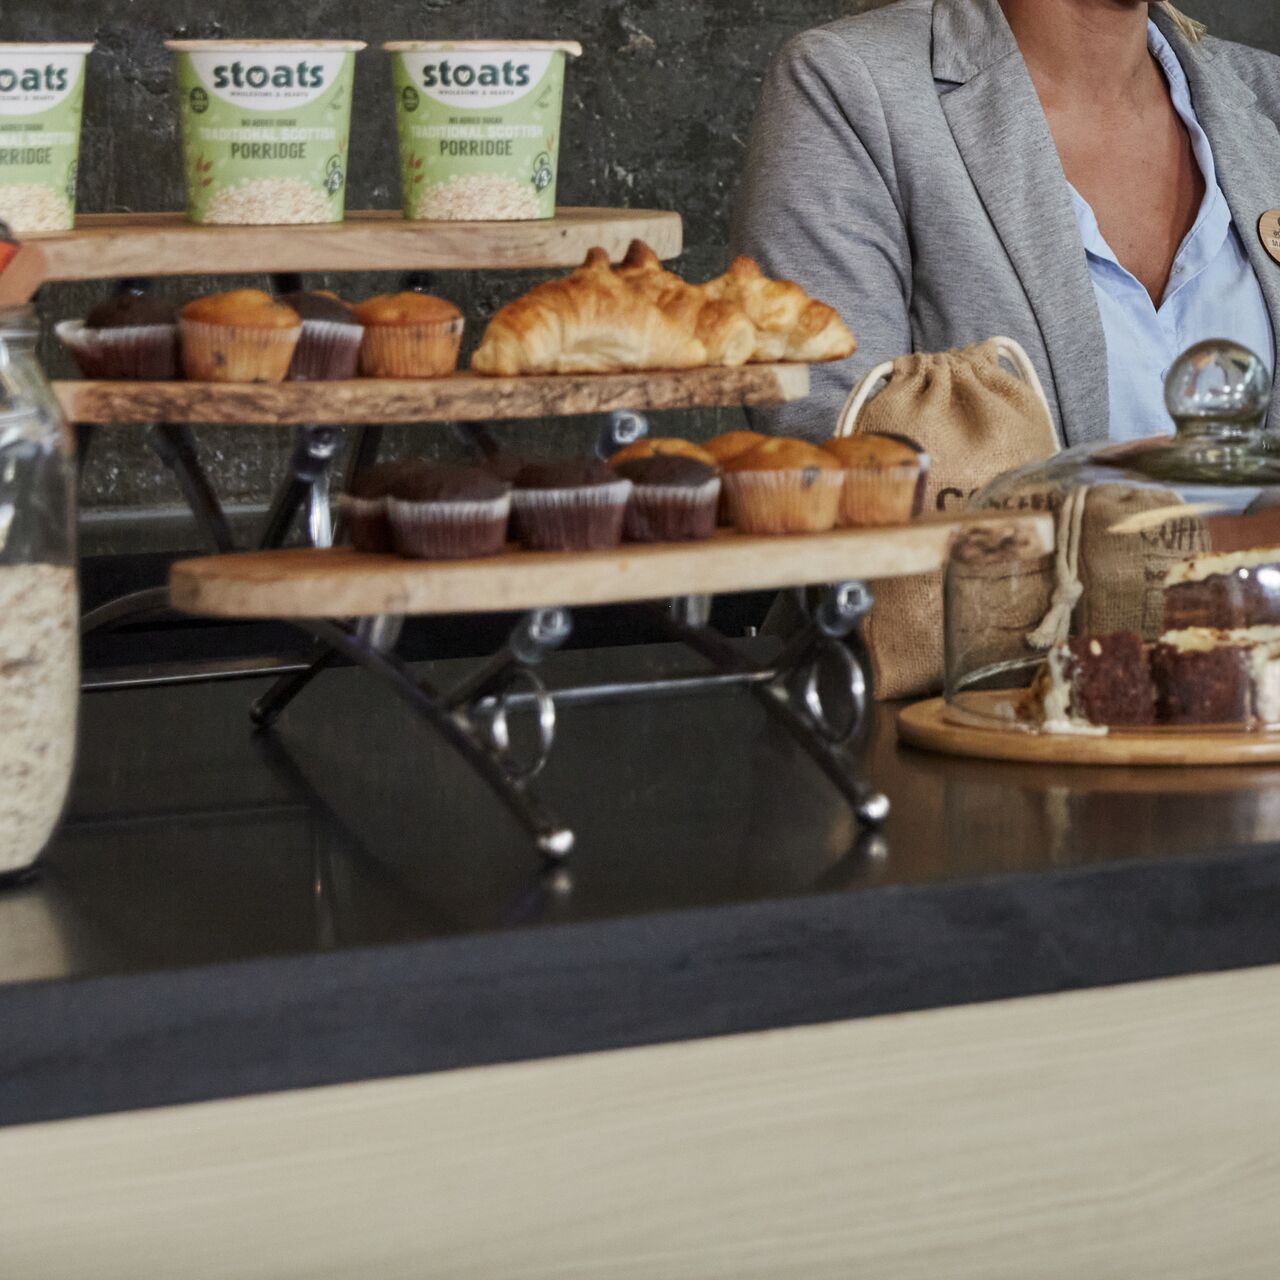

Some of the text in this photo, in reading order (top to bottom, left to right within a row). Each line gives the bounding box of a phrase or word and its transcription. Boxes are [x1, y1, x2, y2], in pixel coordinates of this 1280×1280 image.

[213, 61, 325, 89] stoats
[422, 59, 530, 87] stoats
[200, 127, 336, 141] TRADITIONAL SCOTTISH
[411, 125, 544, 139] TRADITIONAL SCOTTISH
[231, 142, 307, 160] PORRIDGE
[440, 140, 513, 157] PORRIDGE
